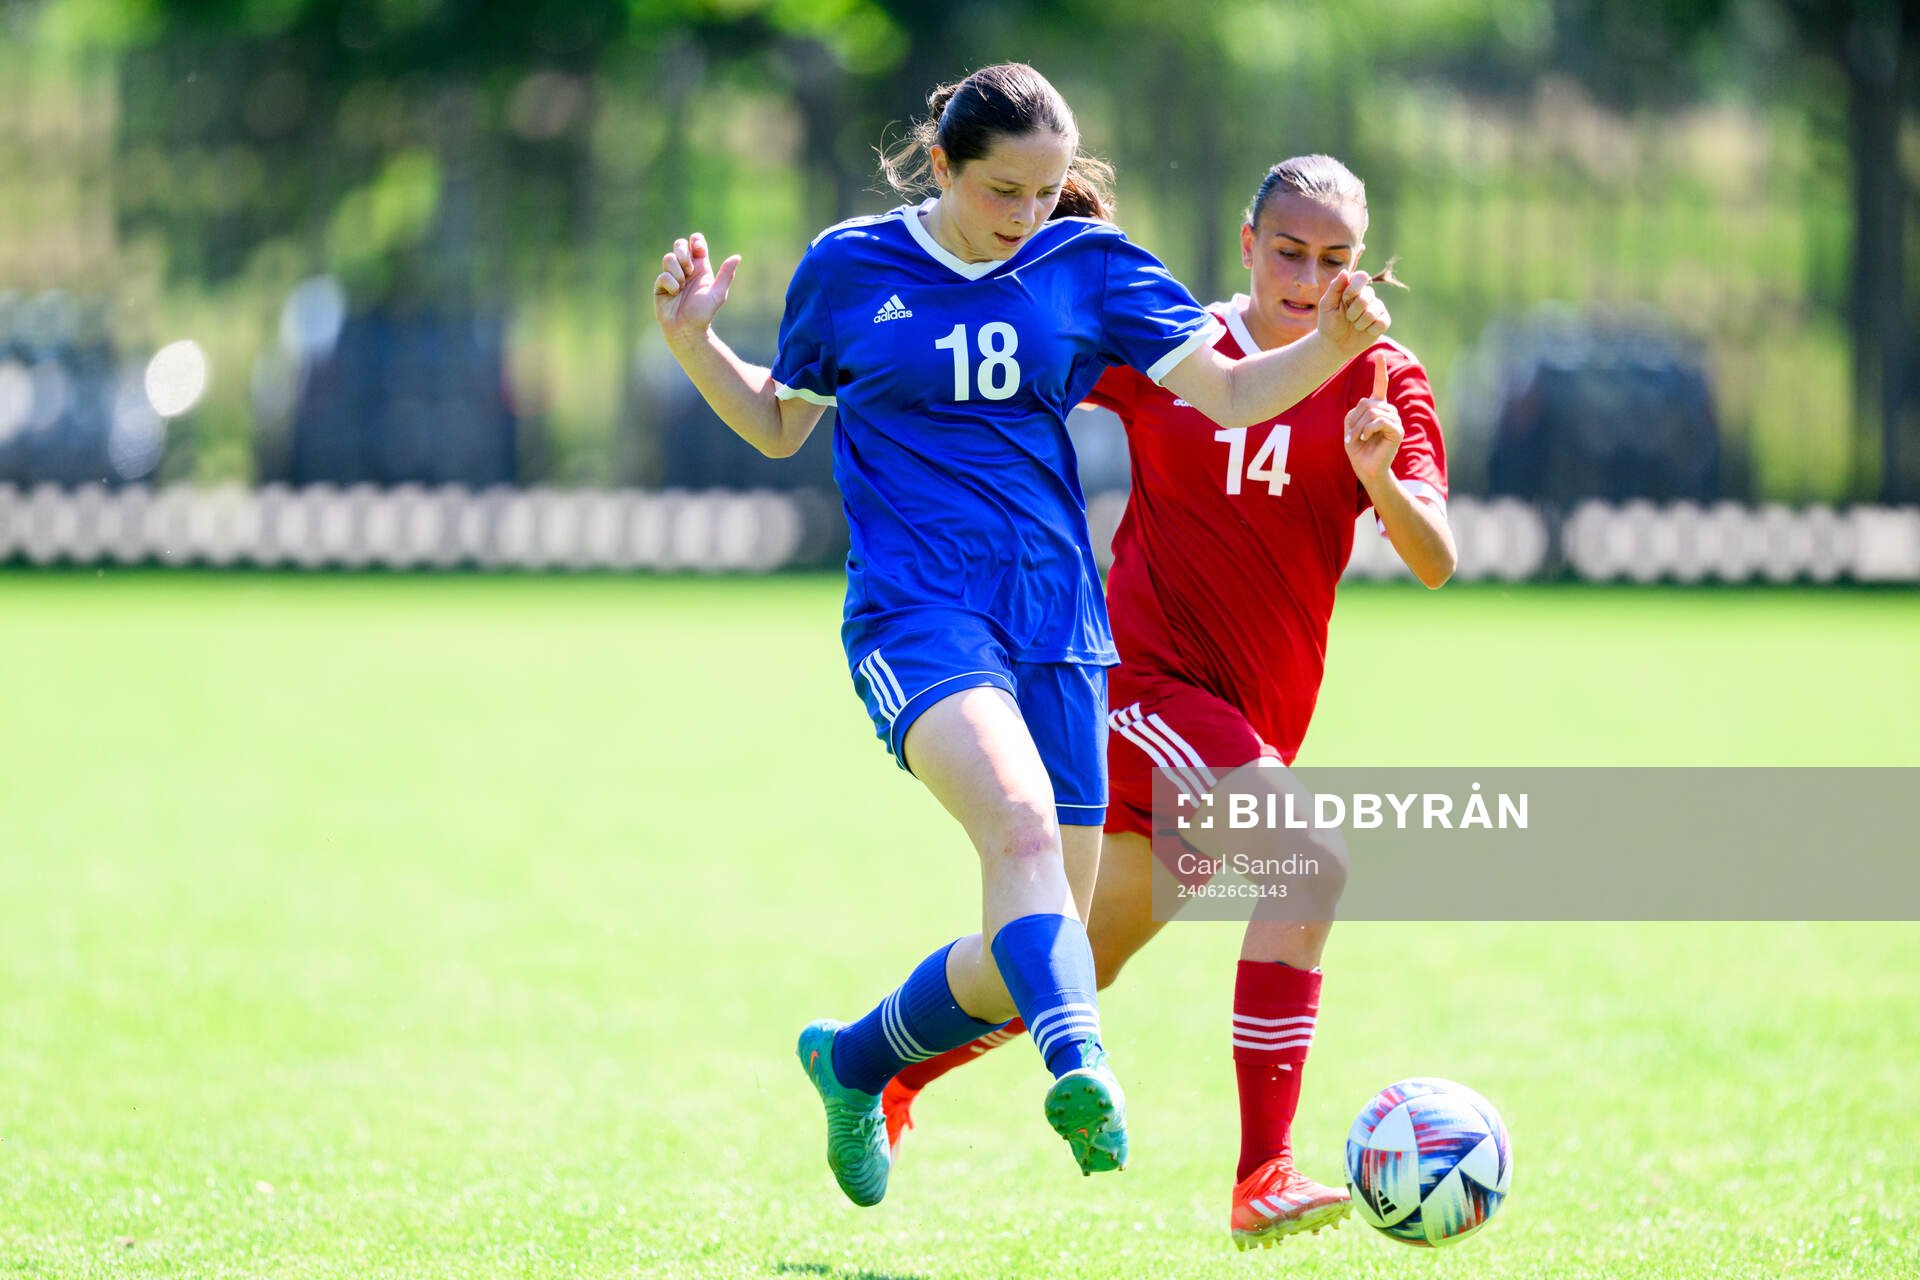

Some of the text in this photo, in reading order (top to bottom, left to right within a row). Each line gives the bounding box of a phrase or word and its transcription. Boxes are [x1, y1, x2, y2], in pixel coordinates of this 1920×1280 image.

[873, 310, 913, 323] adidas
[934, 321, 1021, 402] 18
[1213, 424, 1291, 497] 14
